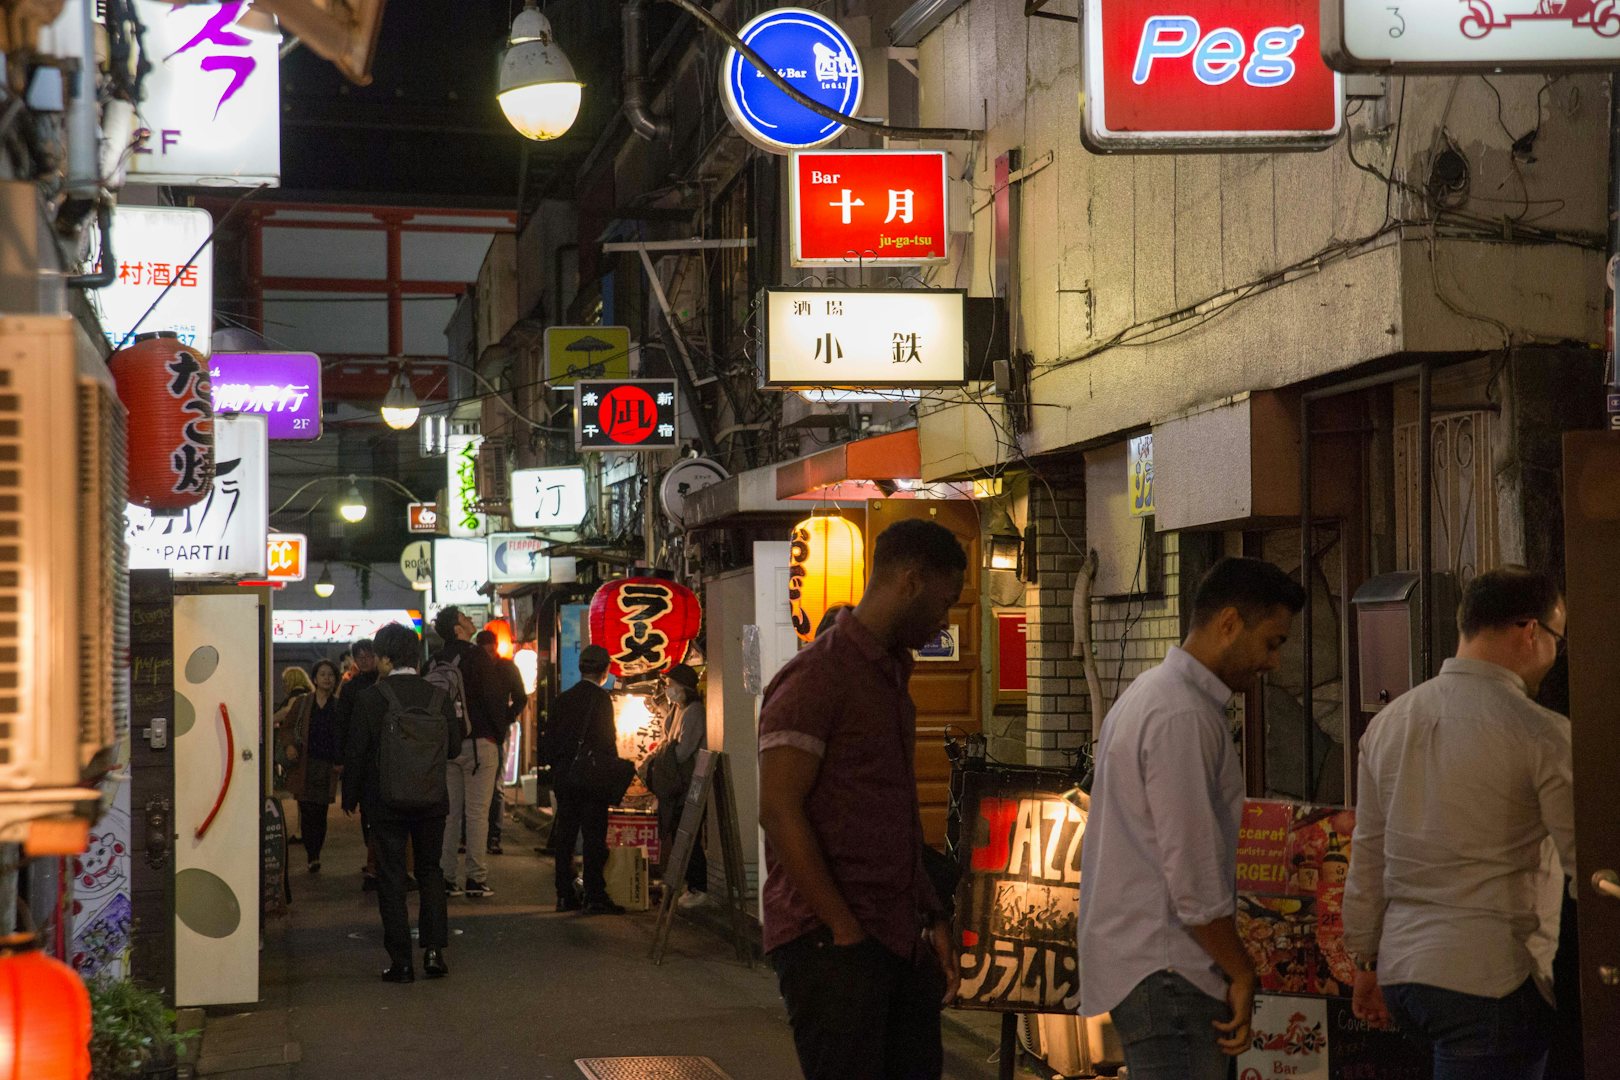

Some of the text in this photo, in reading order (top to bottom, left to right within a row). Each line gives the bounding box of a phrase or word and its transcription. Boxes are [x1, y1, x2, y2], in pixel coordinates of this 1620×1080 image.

[1132, 15, 1304, 88] Peg
[811, 170, 841, 184] Bar
[829, 188, 915, 224] 十月
[879, 234, 932, 249] ju-ga-tsu
[95, 260, 198, 288] 村酒店
[793, 300, 843, 316] 酒場
[813, 332, 923, 364] 小鉄
[293, 418, 311, 430] 2F
[582, 391, 600, 438] 煮干
[656, 391, 675, 438] 新宿
[535, 476, 566, 519] 汀
[164, 545, 214, 560] PART
[970, 797, 1084, 884] JAZZ
[1238, 827, 1285, 842] ccarat
[1236, 863, 1285, 881] RGE!!
[1273, 1060, 1298, 1075] Bar
